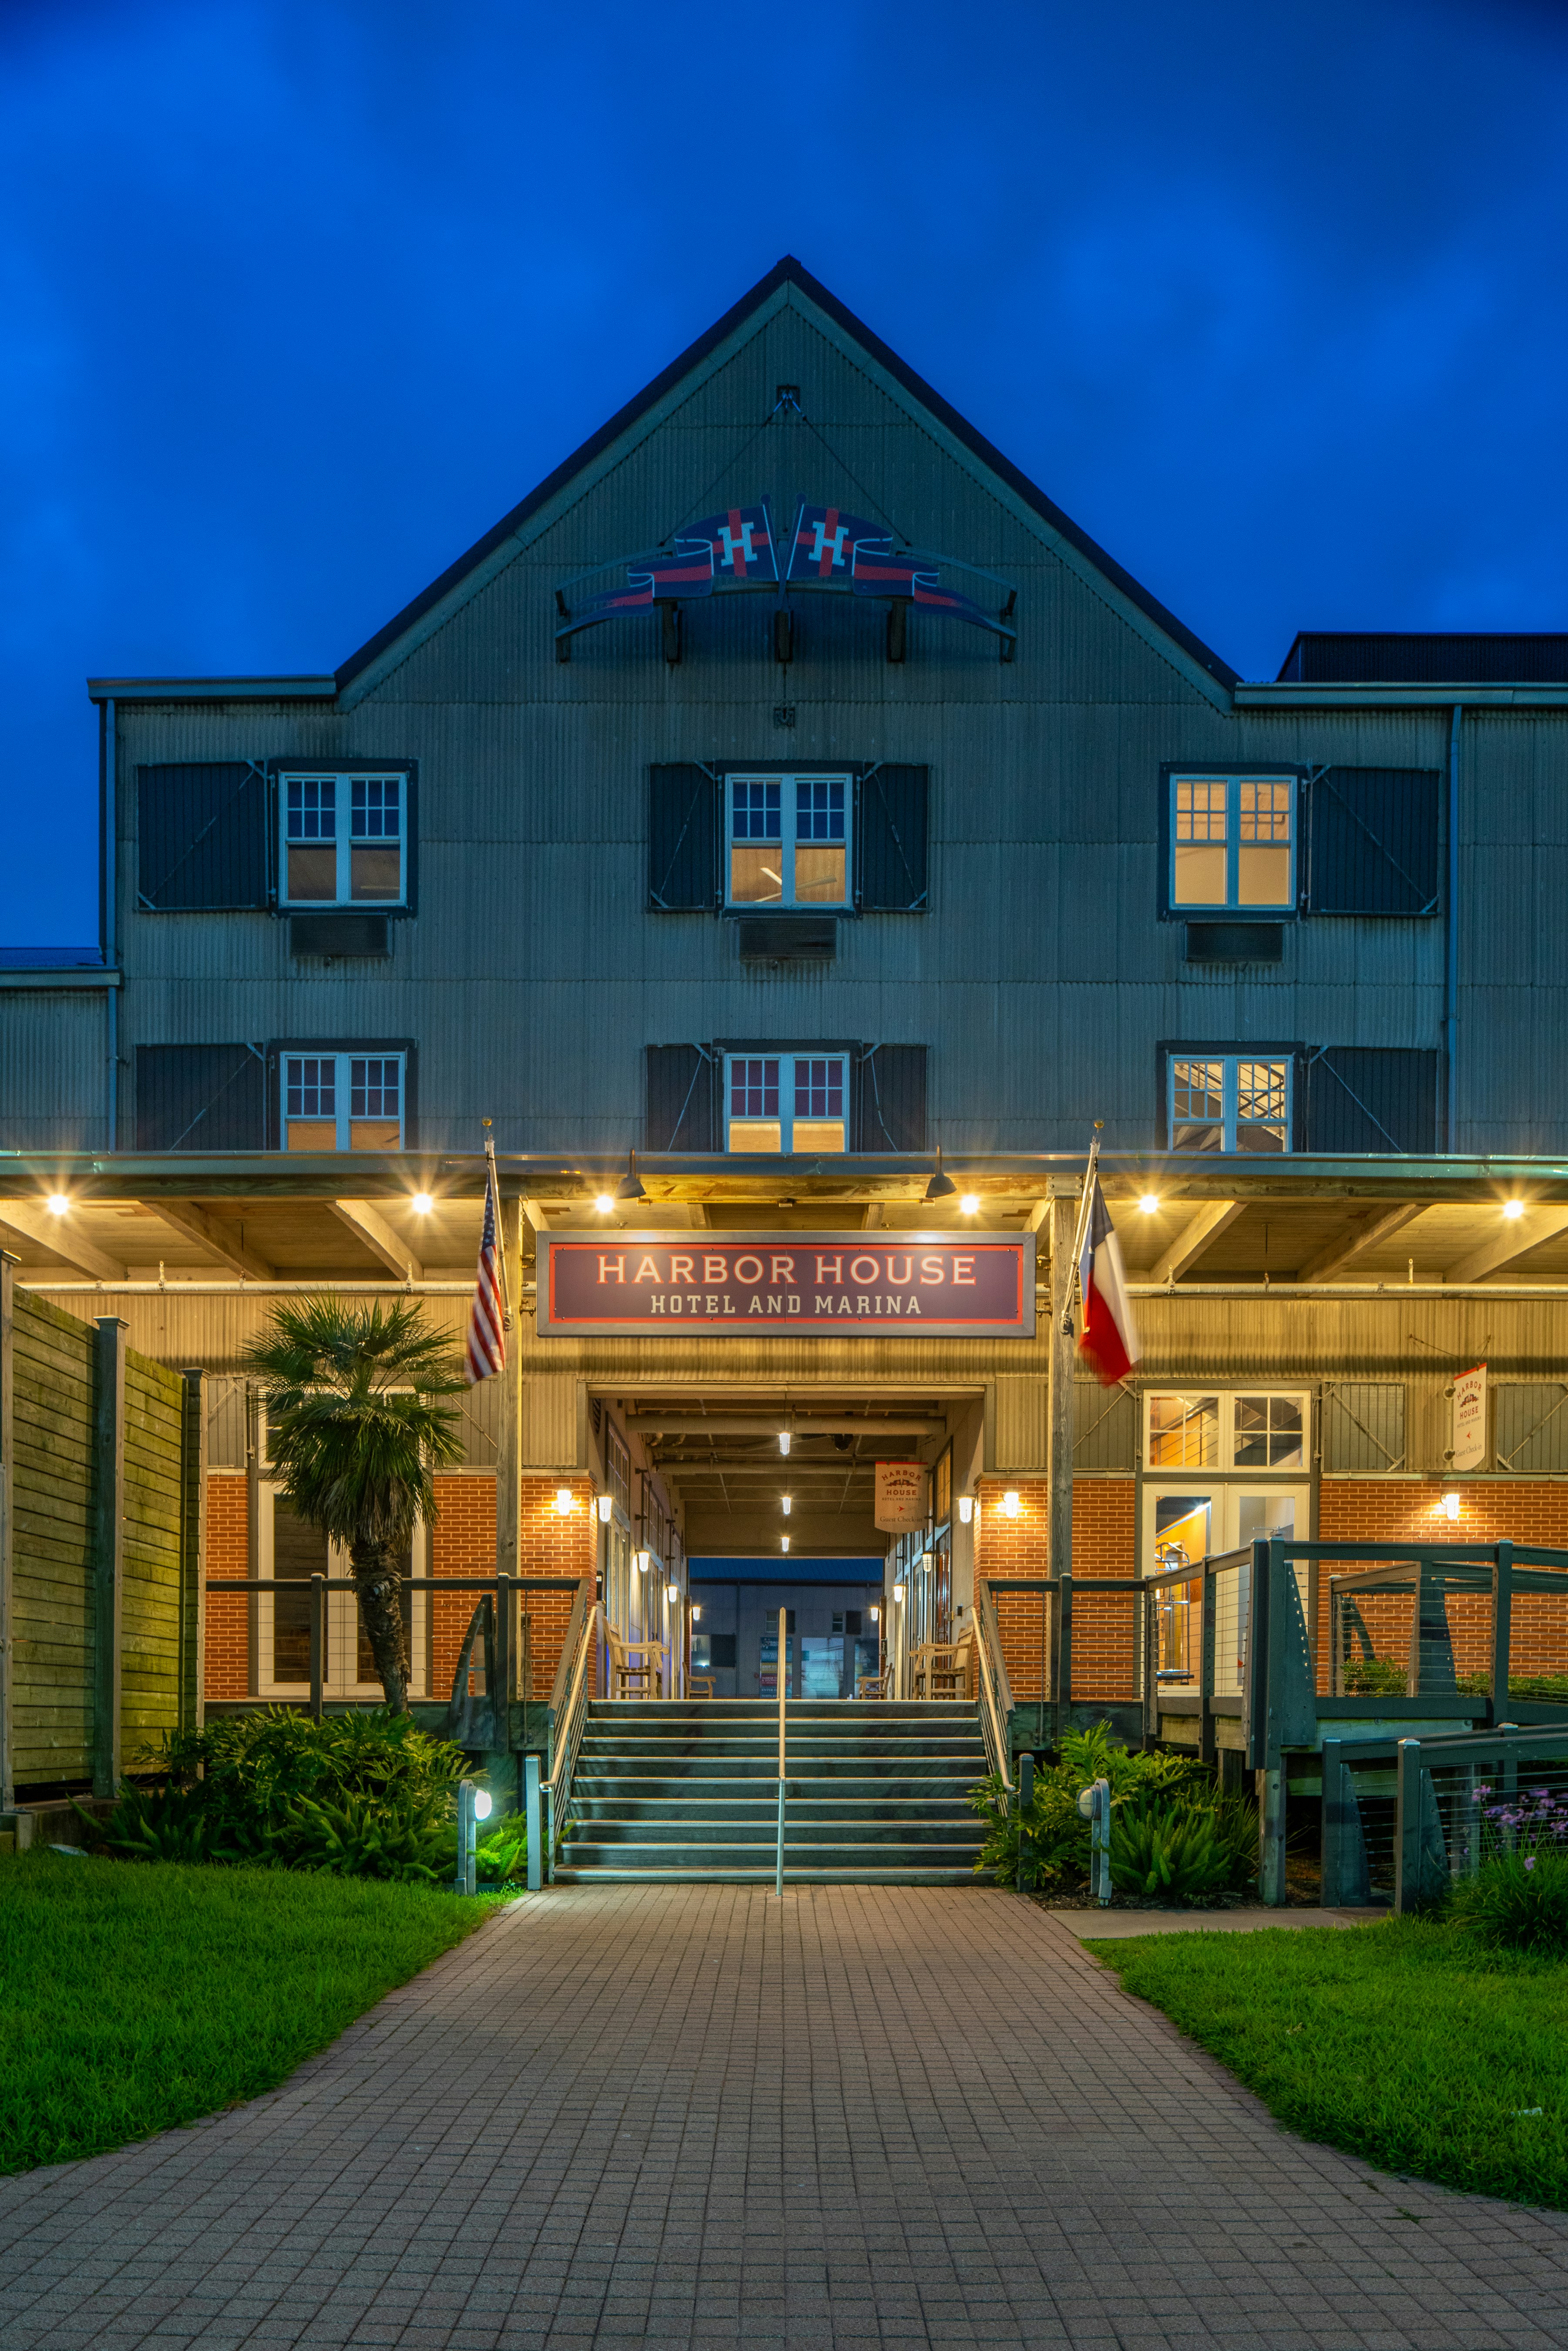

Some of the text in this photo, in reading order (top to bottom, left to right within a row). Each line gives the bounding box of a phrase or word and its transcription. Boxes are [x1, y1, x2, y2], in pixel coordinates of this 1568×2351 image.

[718, 522, 757, 566] H
[808, 522, 849, 566] H
[596, 1255, 977, 1286] HARBOR HOUSE
[651, 1295, 922, 1314] HOTEL AND MARINA
[1457, 1381, 1481, 1401] HARBOR
[1460, 1406, 1478, 1420] HOUSE
[1466, 1443, 1482, 1454] Check-in
[882, 1470, 921, 1481] HARBOR
